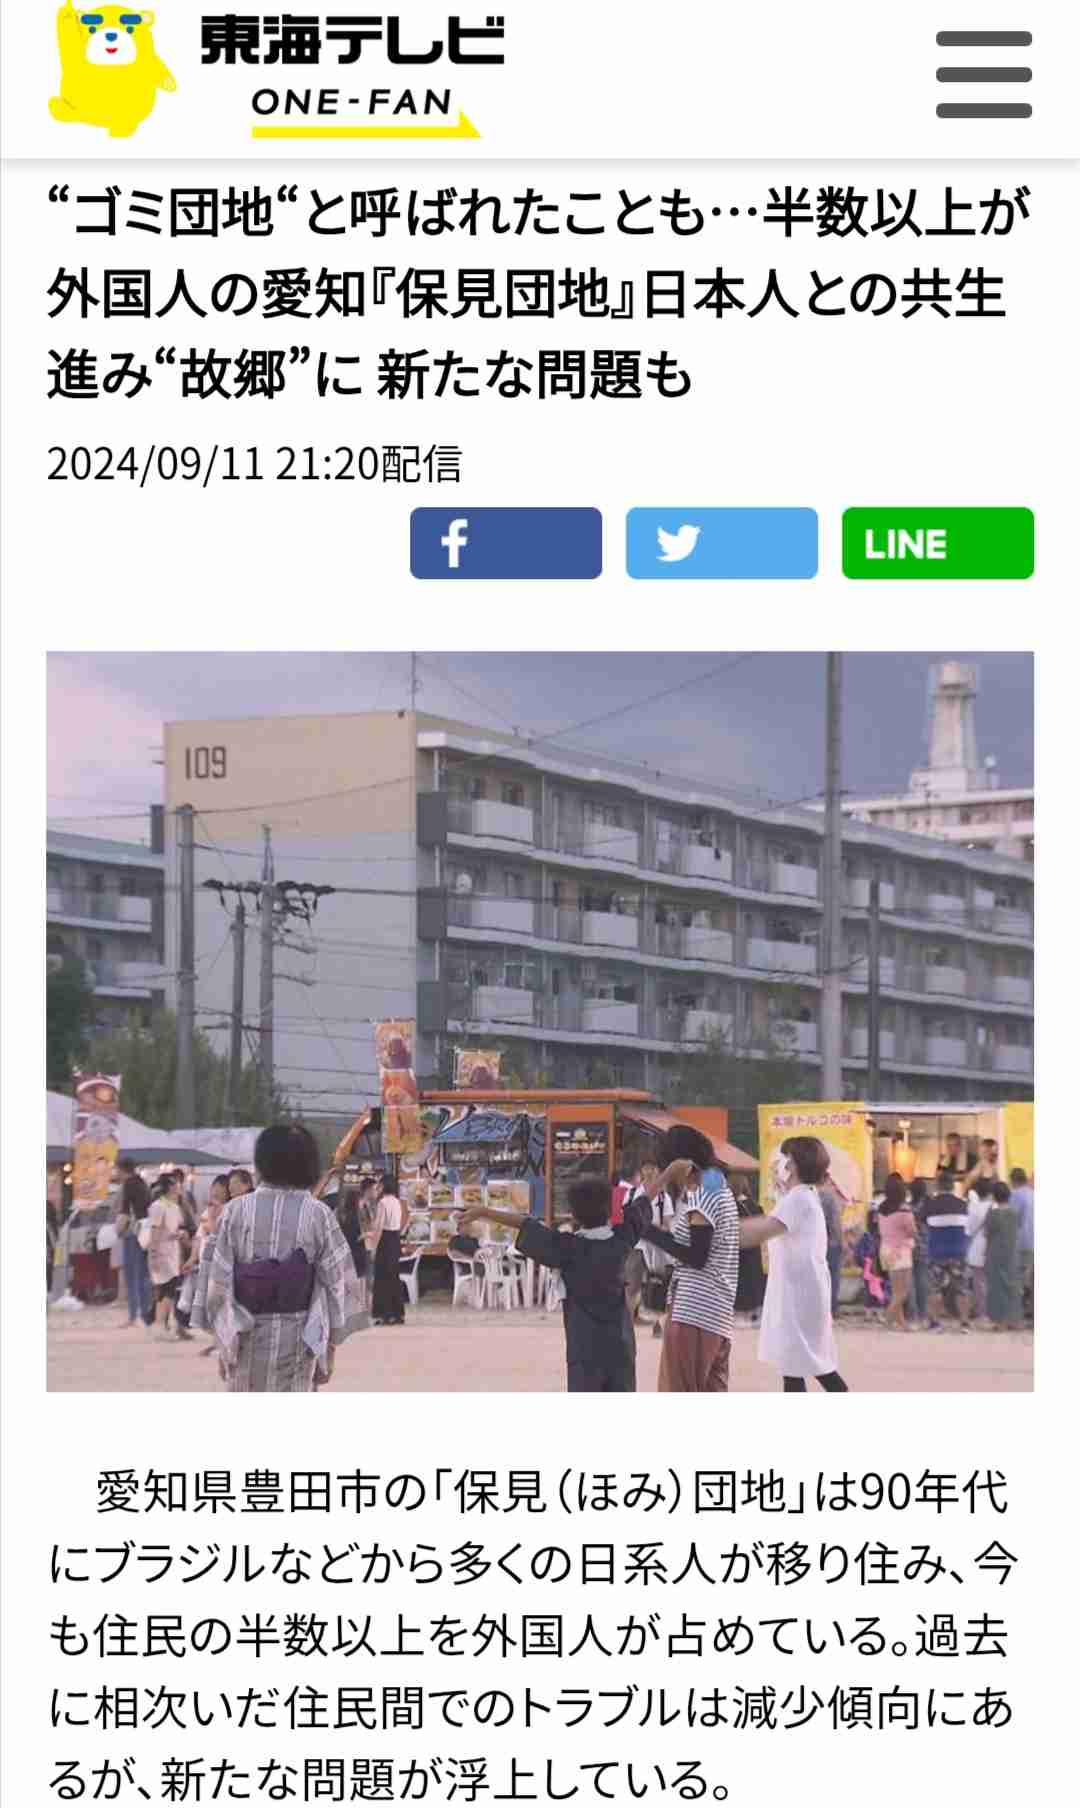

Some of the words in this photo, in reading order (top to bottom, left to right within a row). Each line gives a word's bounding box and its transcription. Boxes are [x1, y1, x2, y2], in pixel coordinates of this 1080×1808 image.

[200, 14, 506, 65] 東海テレビ
[46, 266, 1008, 320] 外国人の愛知『保見団地』日本人との共生
[376, 346, 693, 400] 新たな問題も
[47, 444, 265, 489] 2024/09/11
[276, 444, 463, 489] 21:20配信
[865, 529, 947, 560] LINE
[185, 746, 227, 780] 109
[51, 1539, 1020, 1586] にブラジルなどから多くの日系人が移り住み、今
[50, 1612, 1009, 1659] も住民の半数以上を外国人が占めている。過去
[51, 1683, 1013, 1730] に相次いだ住民間でのトラブルは減少傾向にあ
[48, 1756, 733, 1803] るが、新たな問題が浮上している。
